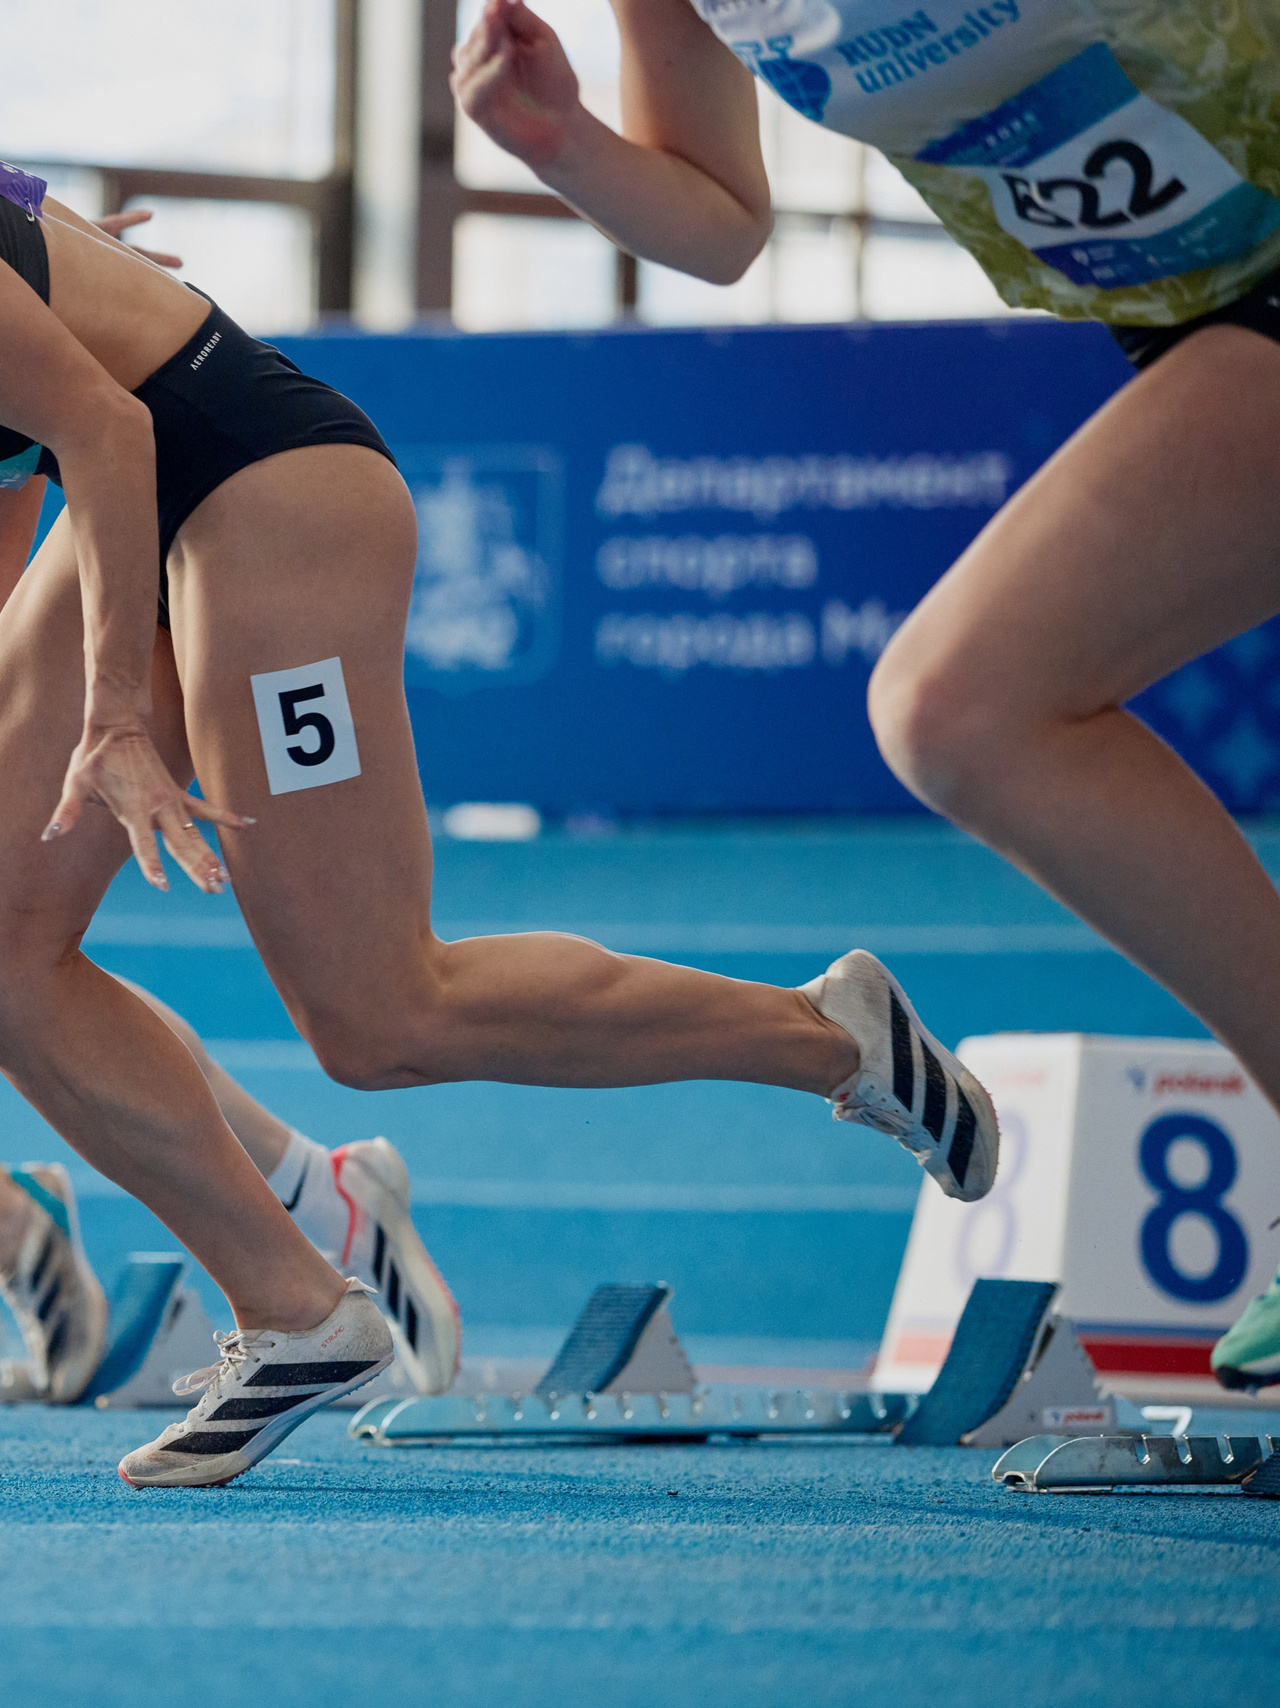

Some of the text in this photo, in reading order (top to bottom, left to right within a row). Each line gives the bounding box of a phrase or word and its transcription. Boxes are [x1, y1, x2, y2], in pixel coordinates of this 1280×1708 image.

[835, 10, 938, 67] RUDN
[854, 0, 1020, 93] university
[190, 331, 222, 371] AEROREADY
[600, 445, 1007, 522] Департамент
[598, 536, 815, 597] спорта
[278, 683, 335, 767] 5
[1139, 1111, 1249, 1304] 8
[321, 1325, 345, 1349] STRUNG
